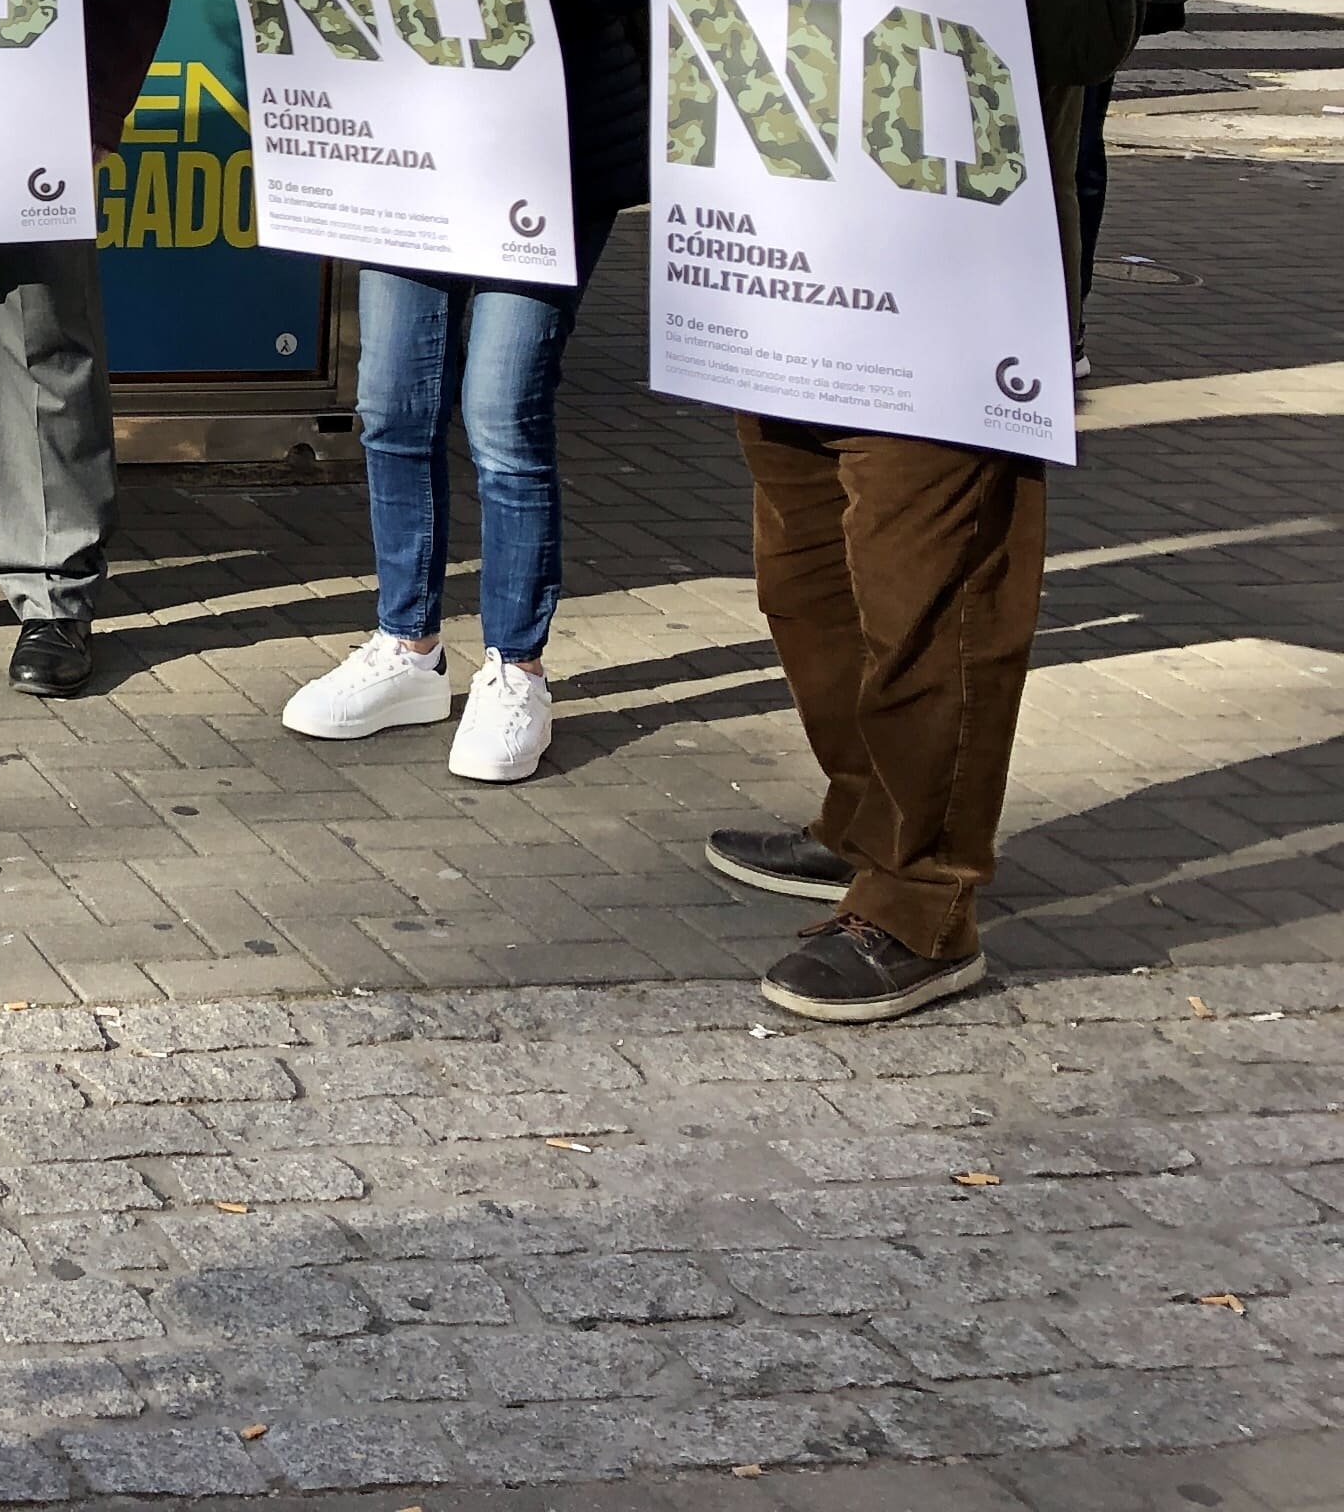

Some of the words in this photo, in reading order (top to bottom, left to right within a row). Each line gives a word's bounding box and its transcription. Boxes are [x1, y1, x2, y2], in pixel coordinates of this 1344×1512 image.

[262, 87, 278, 105] A
[284, 88, 332, 109] UNA
[264, 109, 374, 139] CÓRDOBA
[266, 136, 436, 171] MILITARIZADA
[667, 203, 687, 225] A
[696, 209, 757, 236] UNA
[667, 231, 812, 273] CÓRDOBA
[667, 262, 900, 314] MILITARIZADA
